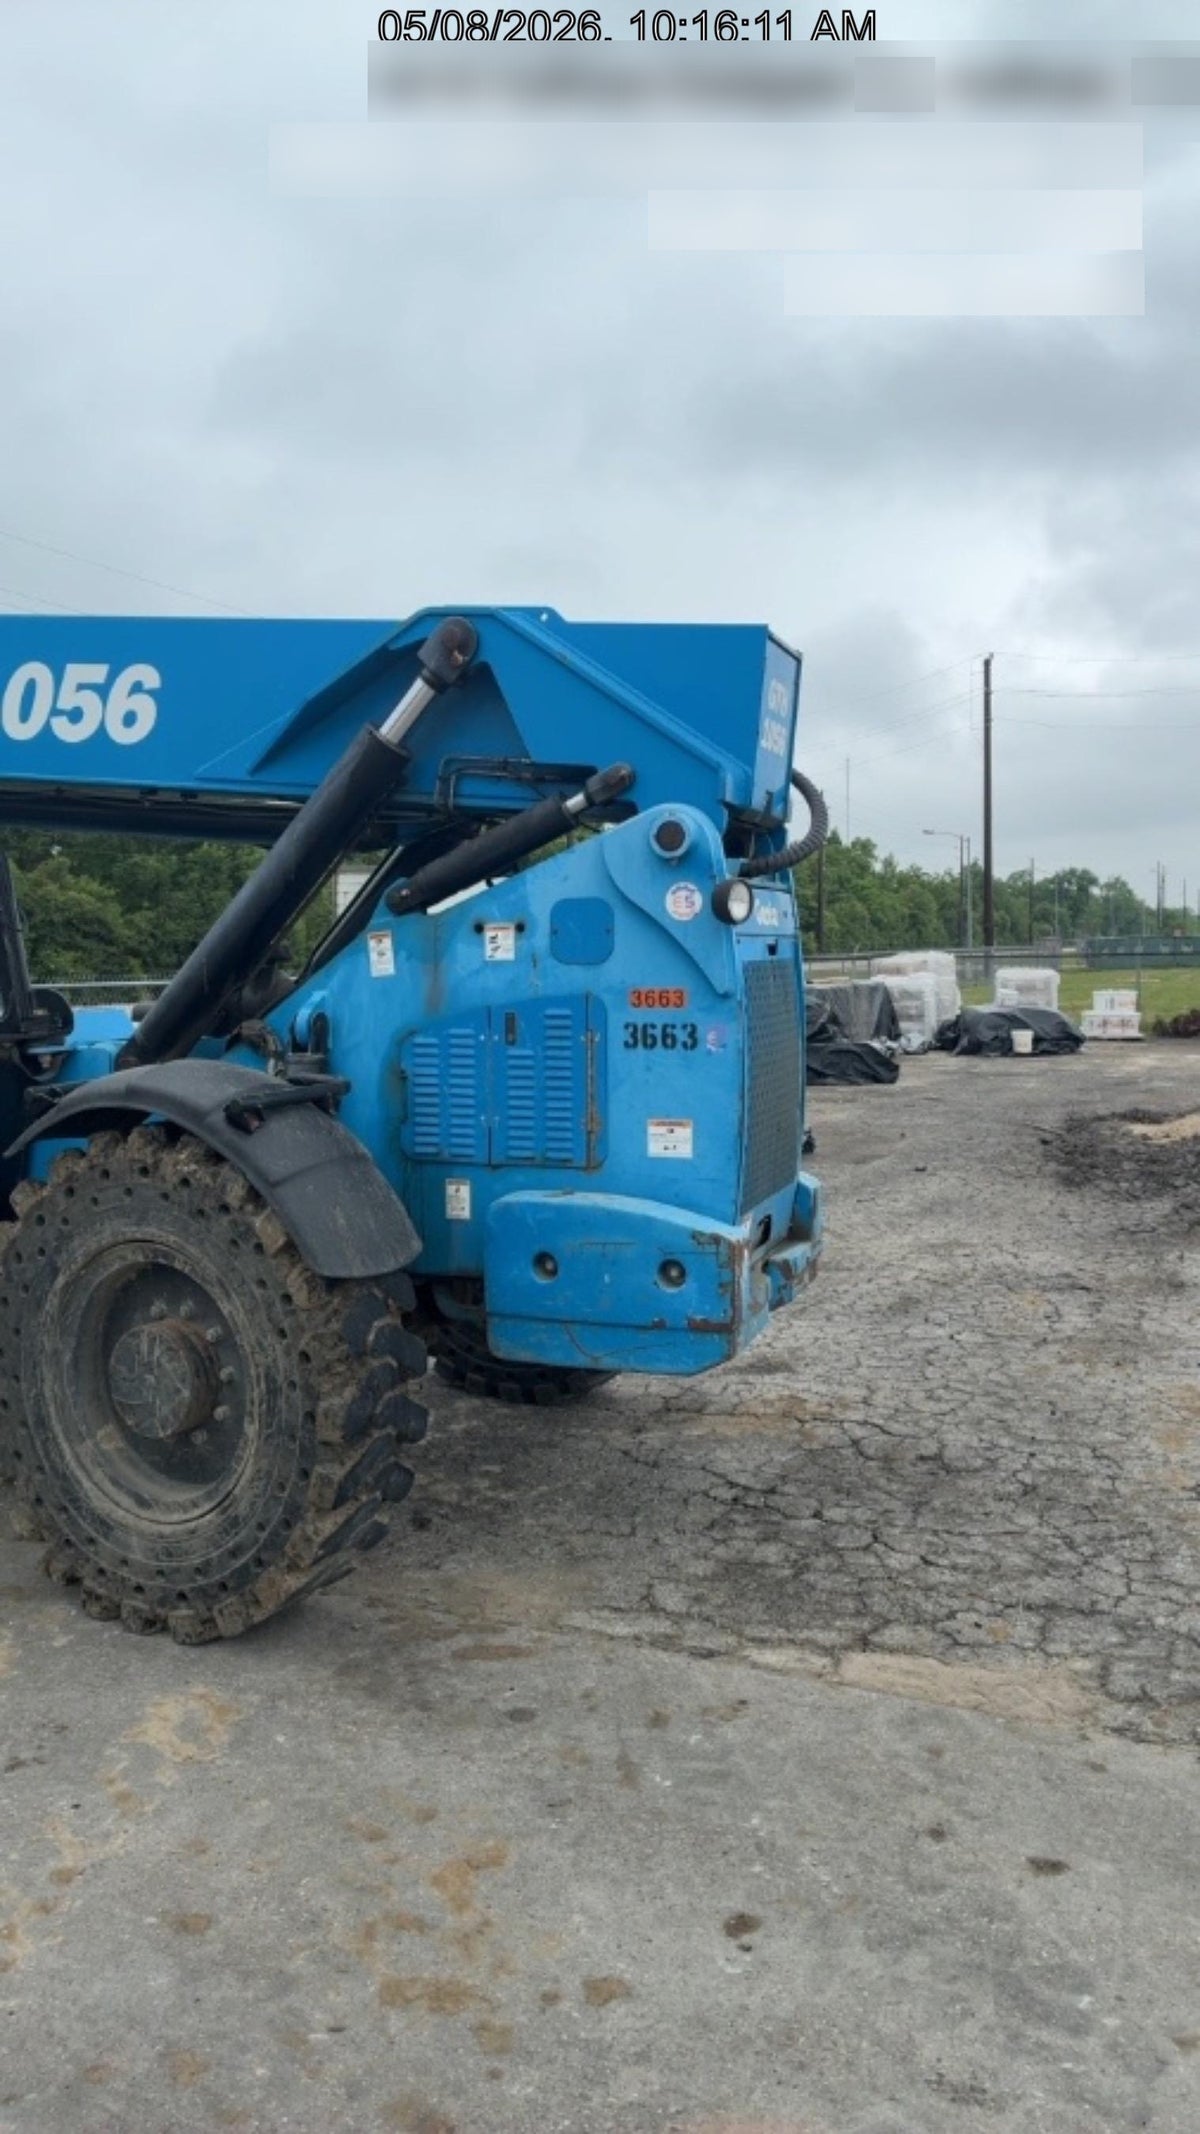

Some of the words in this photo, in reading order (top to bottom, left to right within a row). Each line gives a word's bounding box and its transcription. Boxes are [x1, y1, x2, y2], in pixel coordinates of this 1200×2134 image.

[2, 661, 162, 745] 056
[631, 988, 684, 1009] 3663
[623, 1022, 698, 1051] 3663
